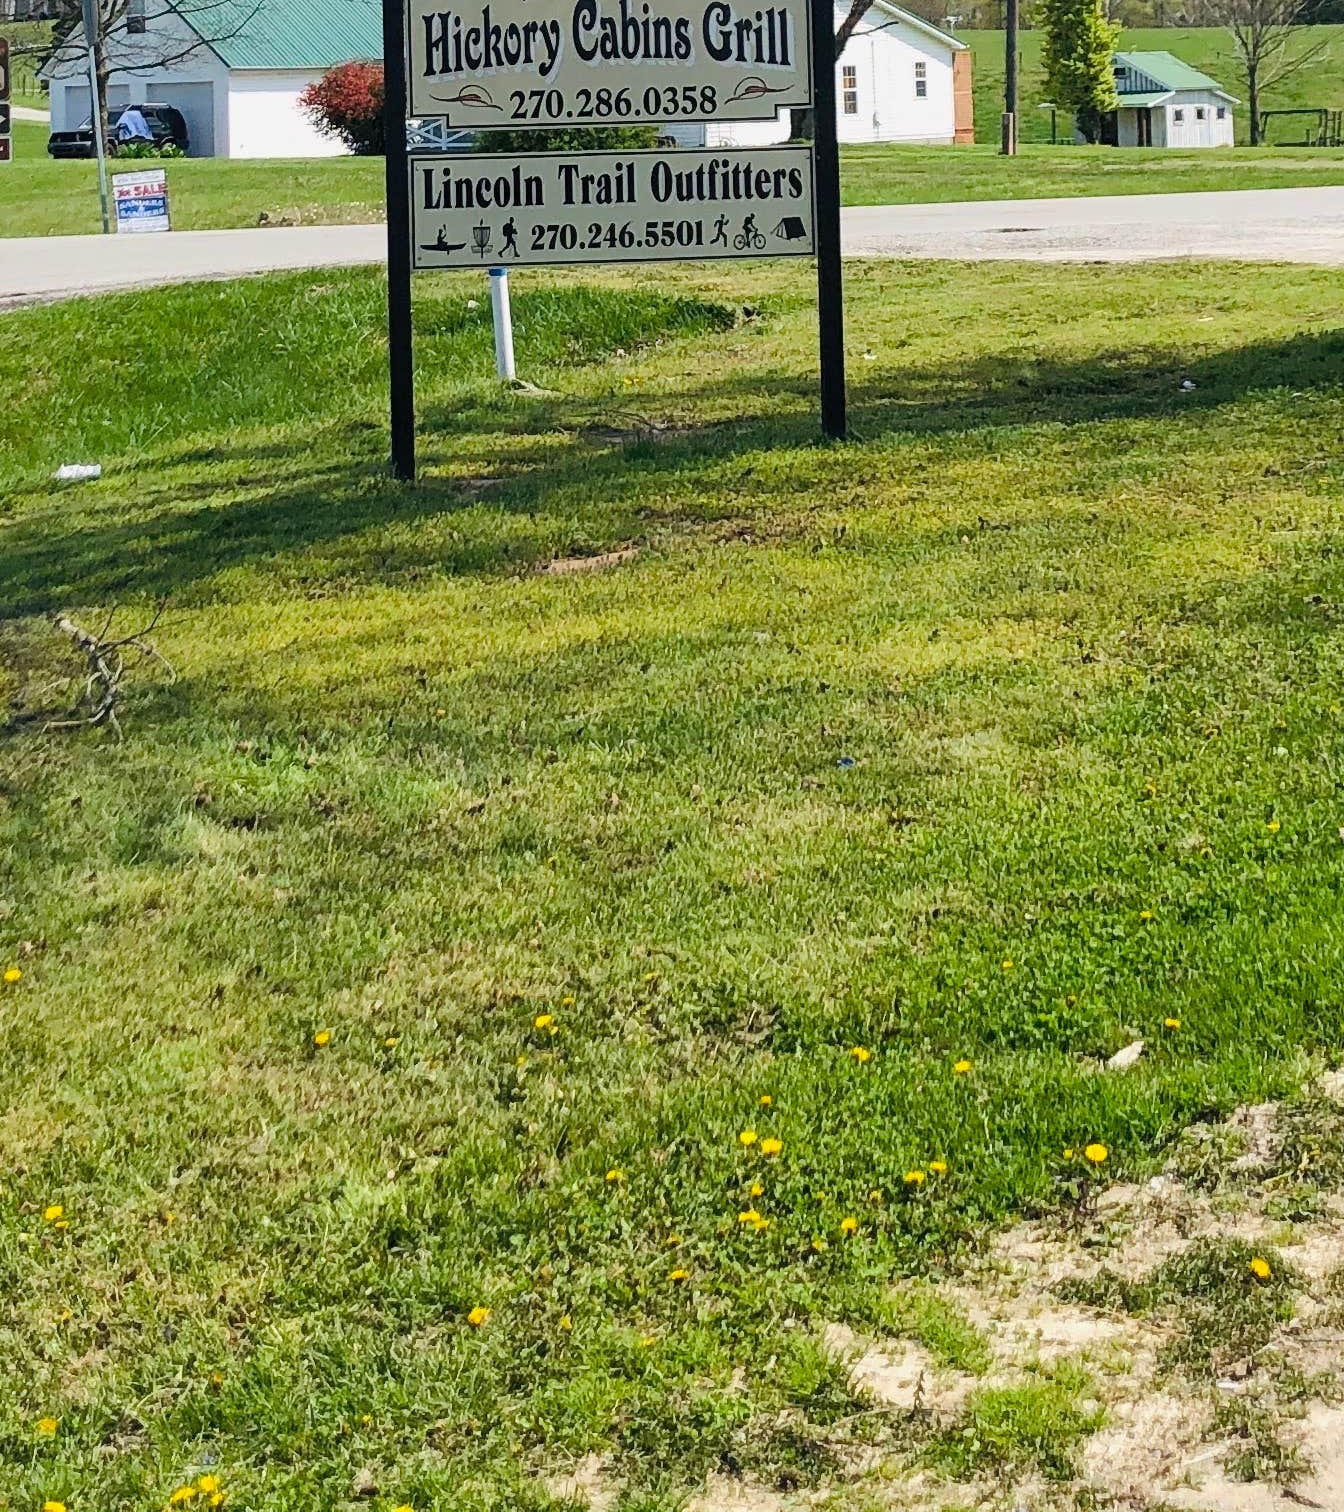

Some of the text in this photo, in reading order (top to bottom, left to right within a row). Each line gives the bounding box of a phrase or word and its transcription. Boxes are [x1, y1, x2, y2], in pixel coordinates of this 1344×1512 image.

[422, 4, 561, 77] Hickory
[702, 1, 792, 66] Grill
[509, 85, 718, 119] 270.286.0358
[422, 158, 803, 210] Lincoln Trail Outfitters
[530, 219, 705, 250] 270.246.5501
